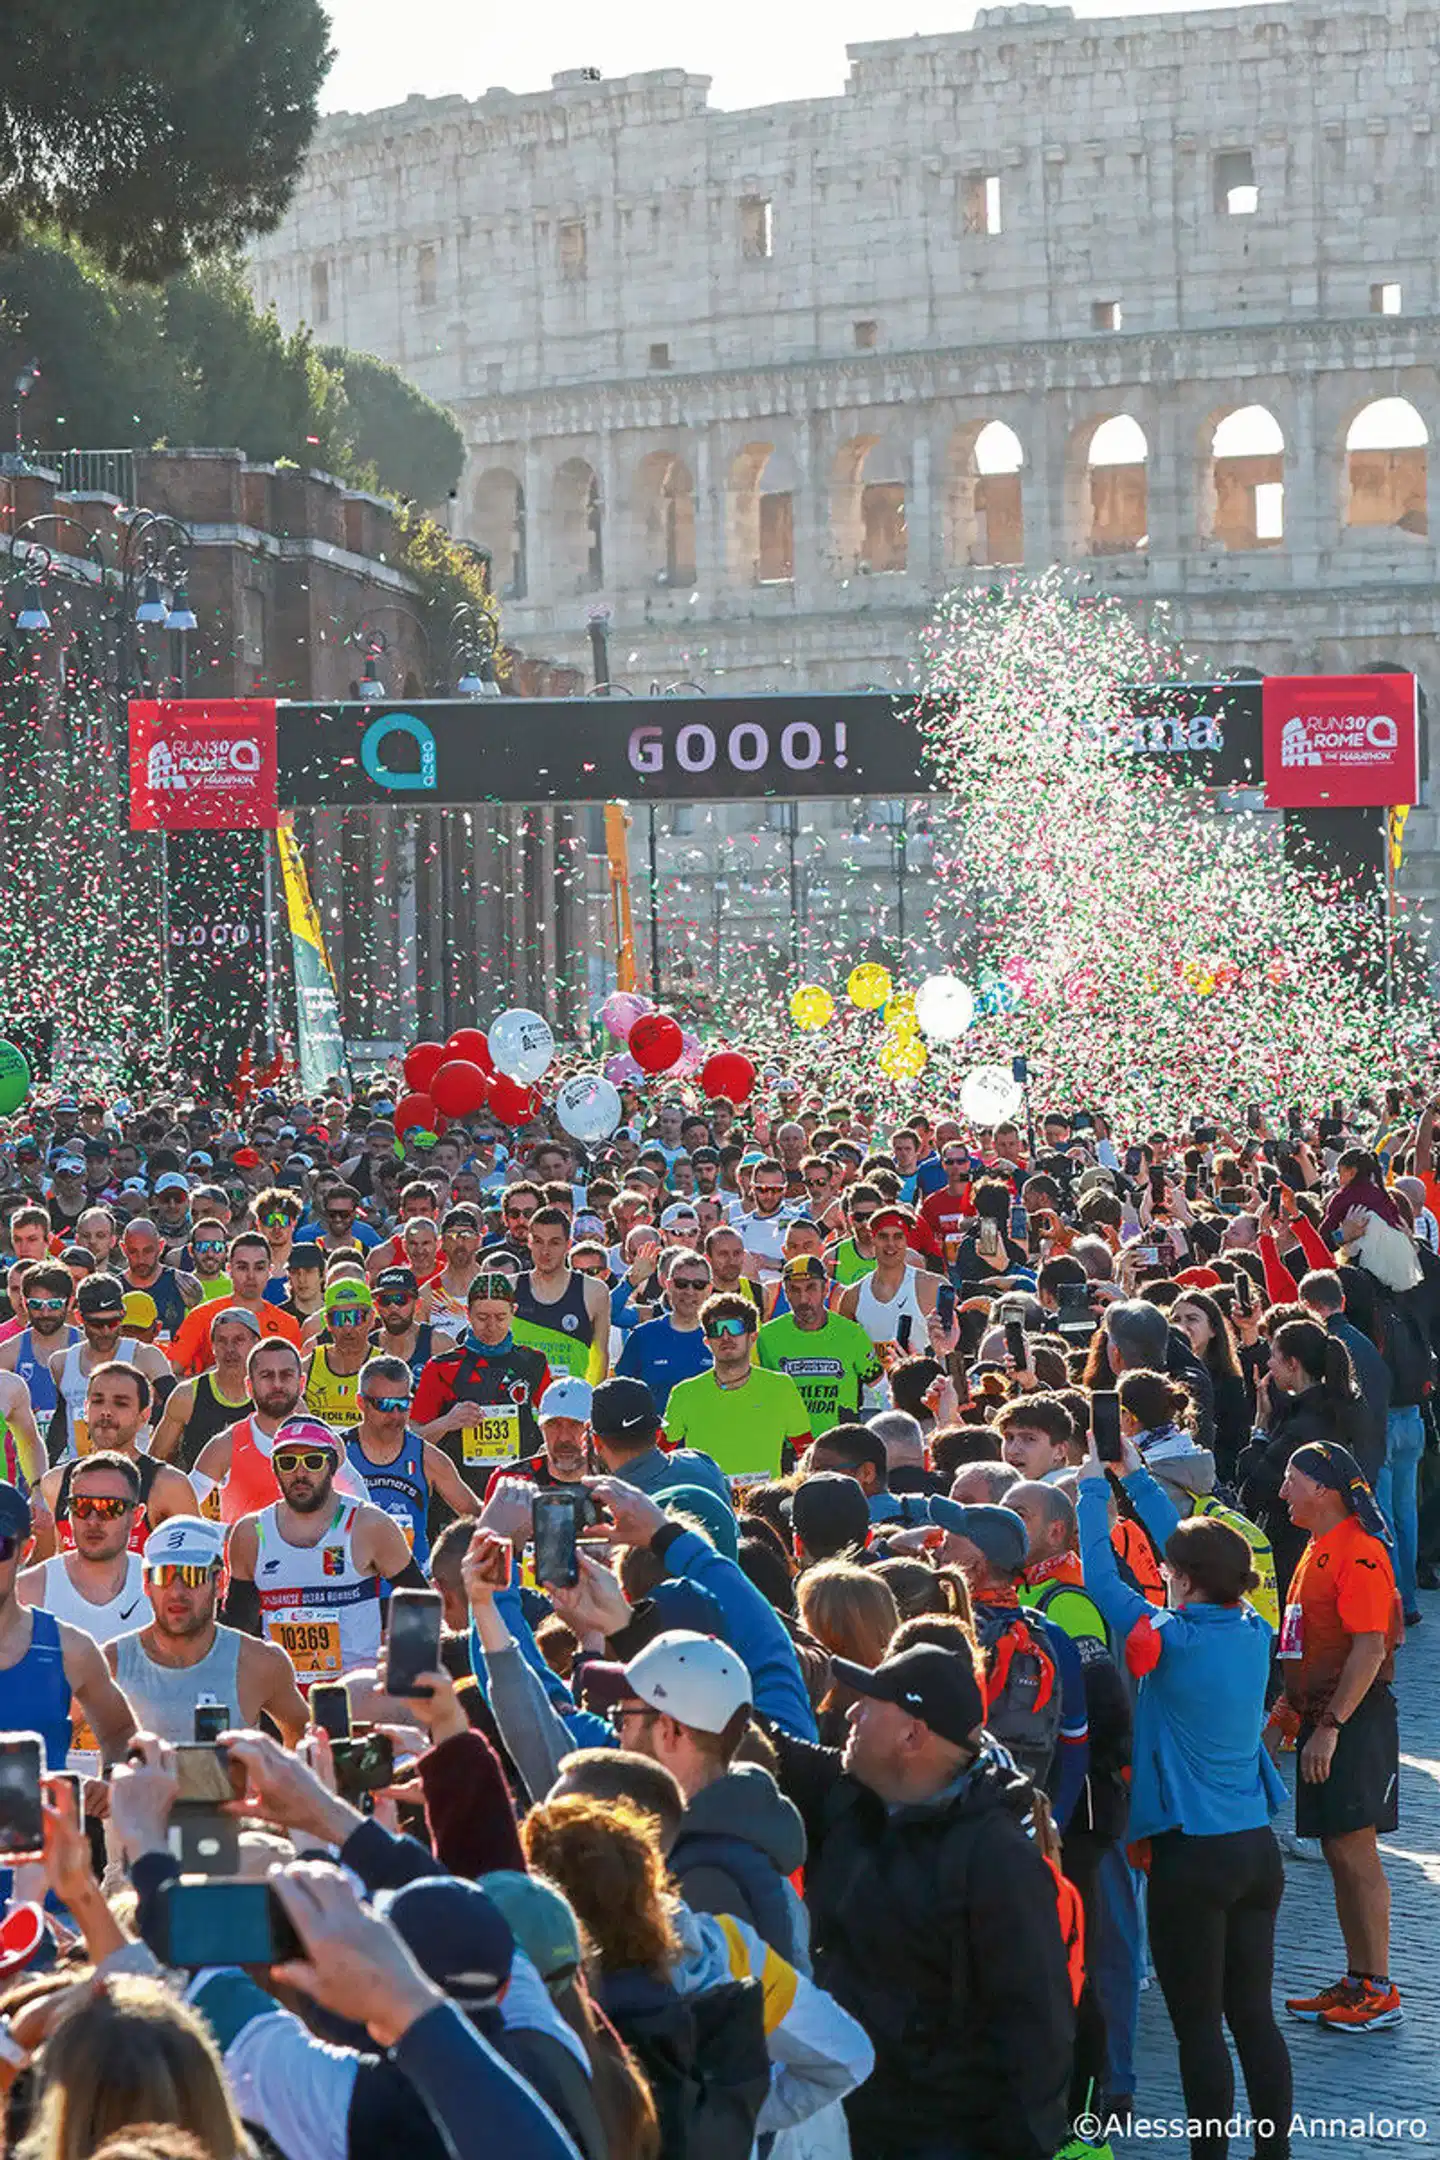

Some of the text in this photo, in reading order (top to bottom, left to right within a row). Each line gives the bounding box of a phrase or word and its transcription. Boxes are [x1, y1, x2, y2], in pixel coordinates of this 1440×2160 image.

[628, 720, 848, 773] GOOO!
[1314, 732, 1364, 747] ROME
[280, 1626, 330, 1651] 10369
[311, 1659, 321, 1671] A
